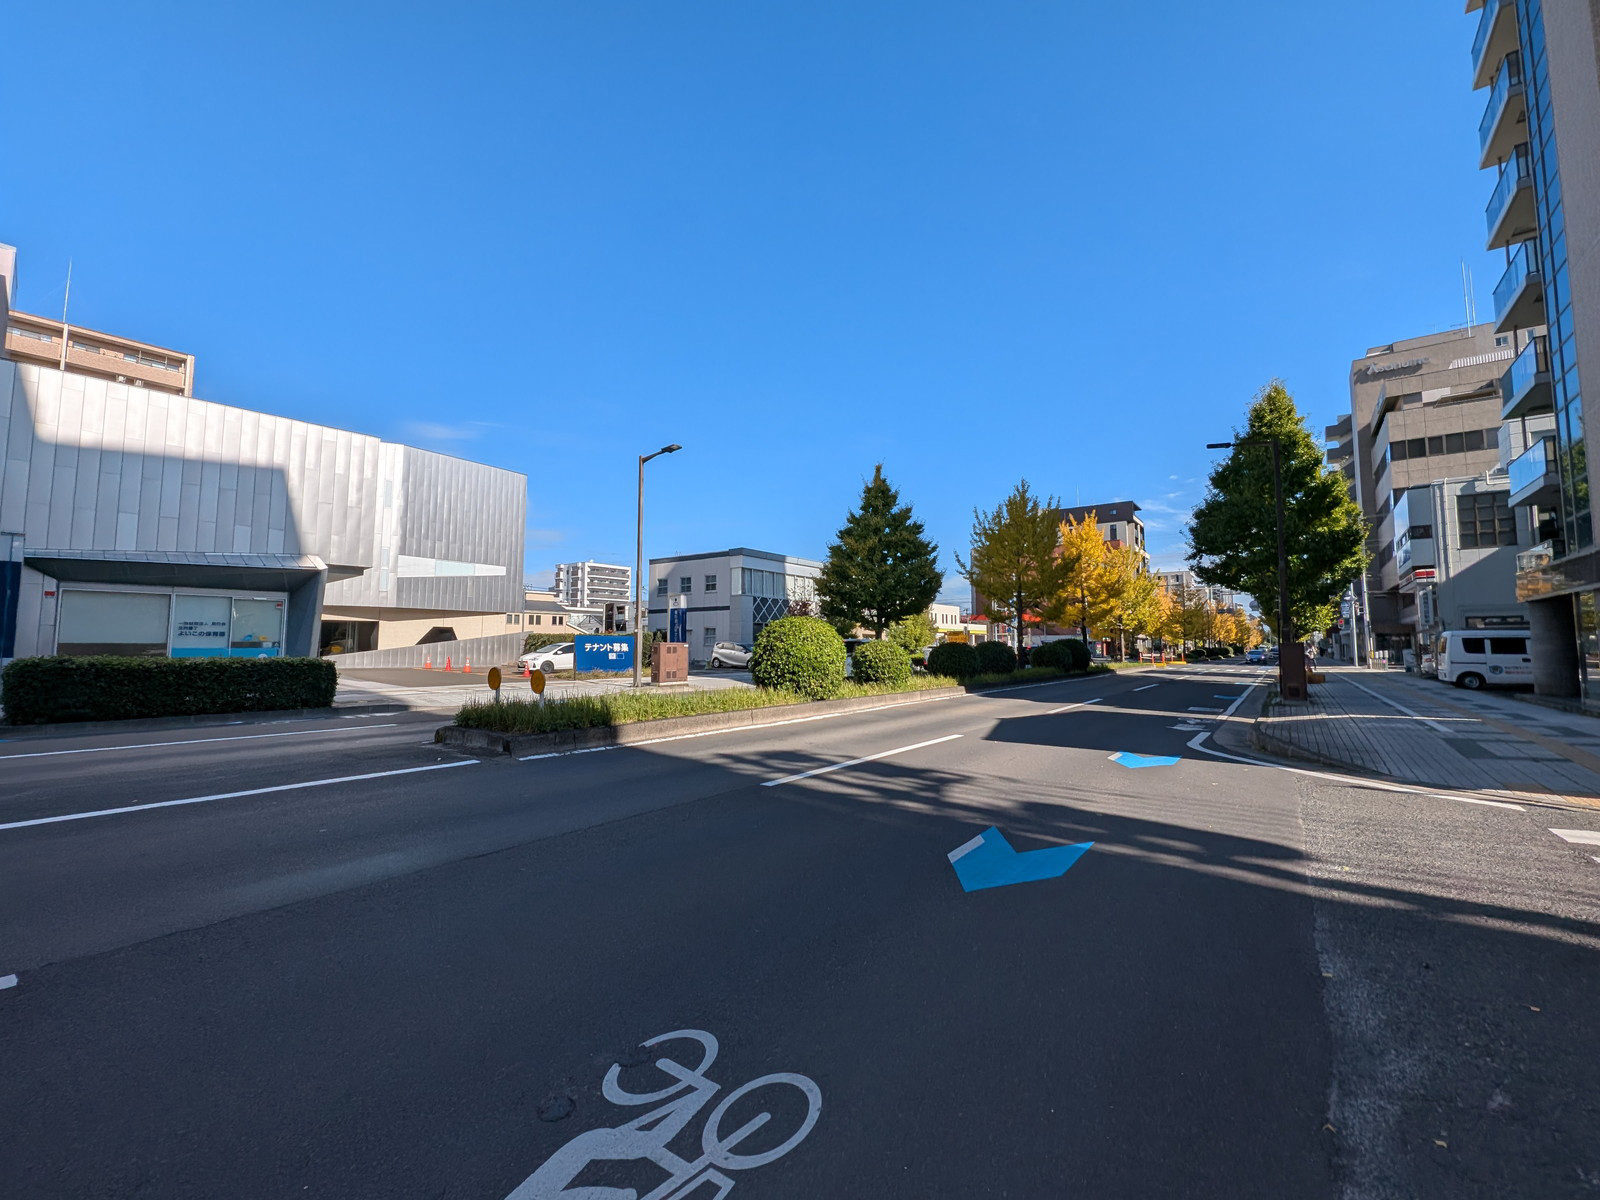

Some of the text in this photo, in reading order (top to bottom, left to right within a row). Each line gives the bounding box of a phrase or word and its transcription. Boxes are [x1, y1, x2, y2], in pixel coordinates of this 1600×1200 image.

[584, 643, 629, 652] テナント募集
